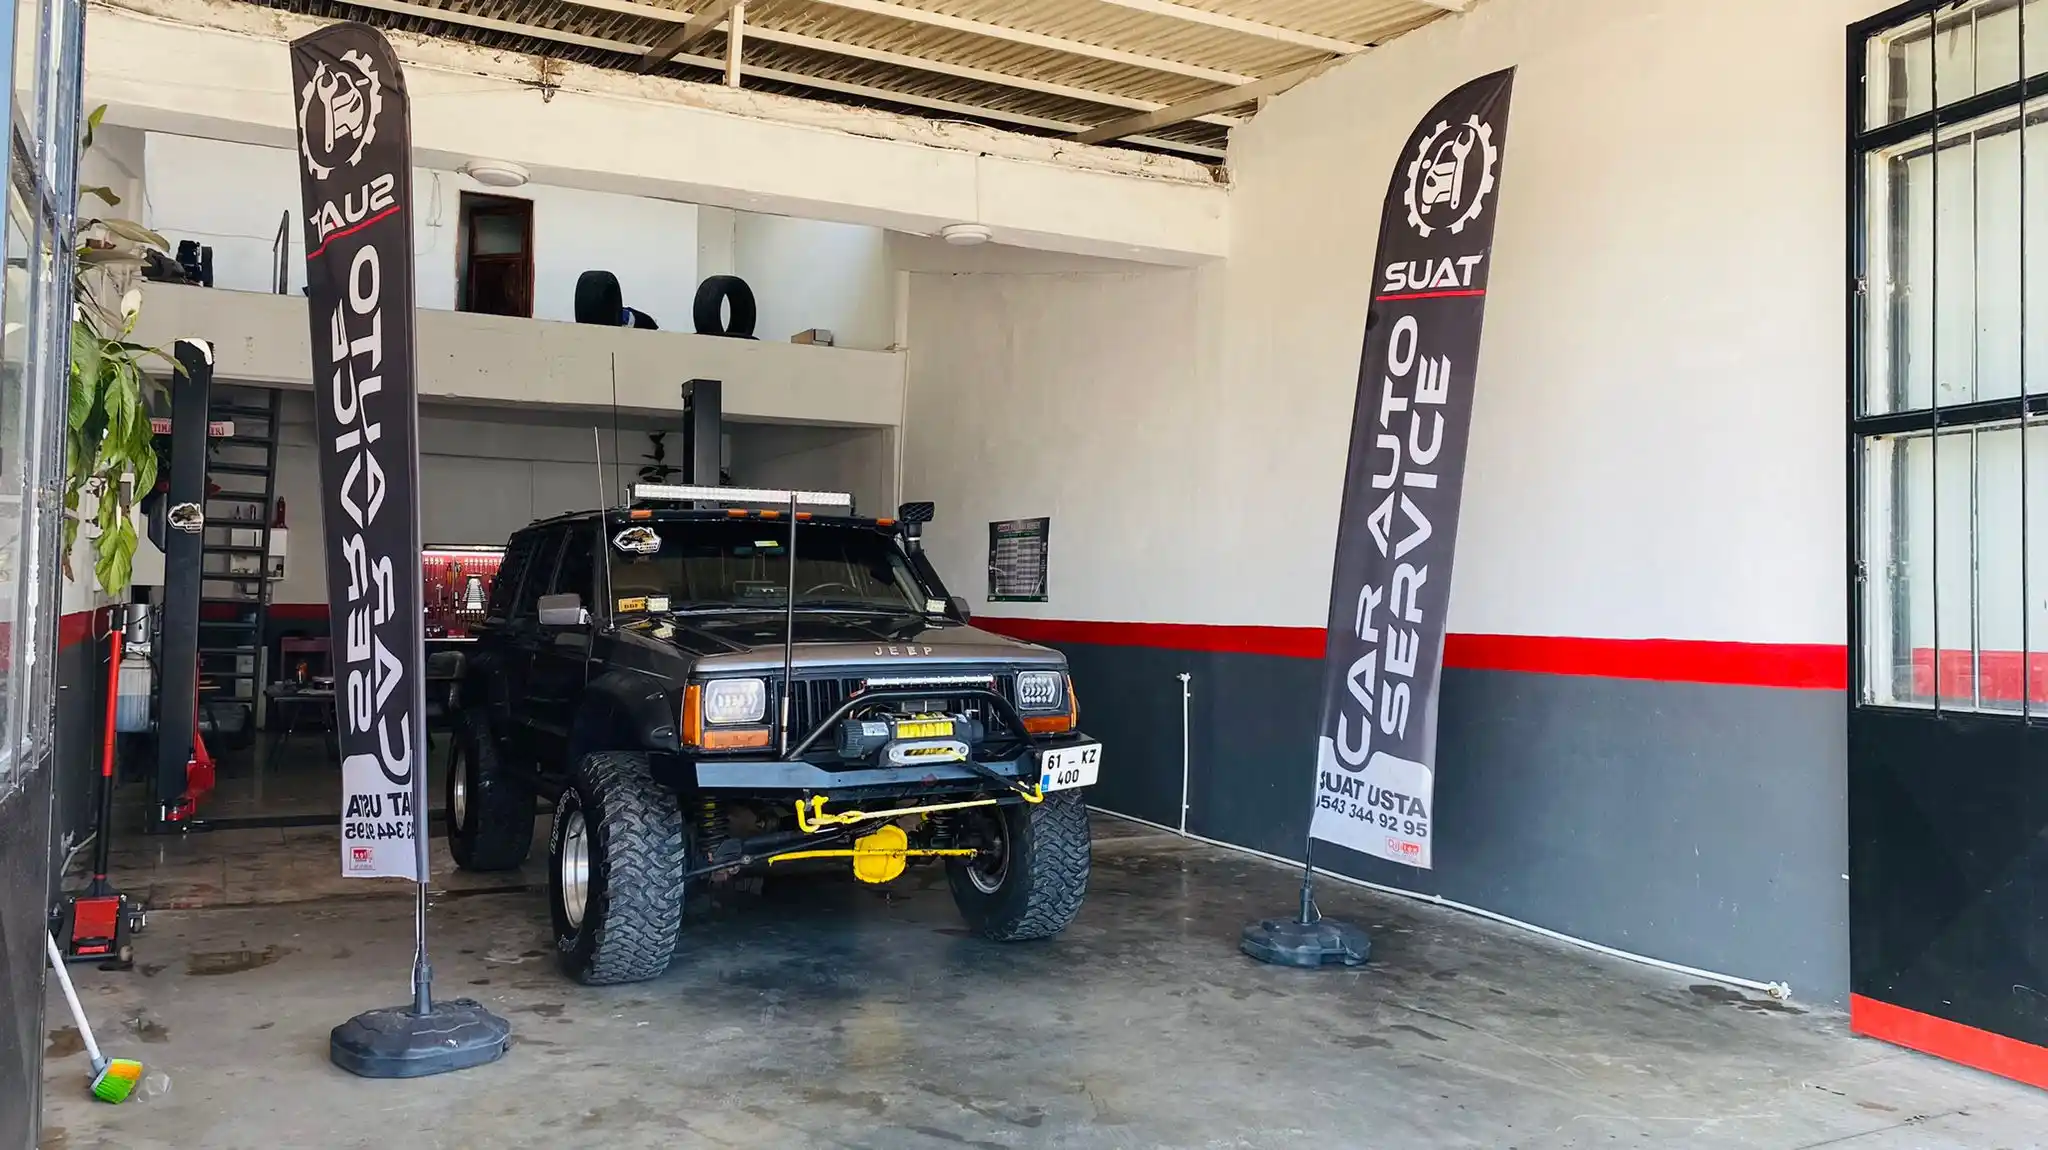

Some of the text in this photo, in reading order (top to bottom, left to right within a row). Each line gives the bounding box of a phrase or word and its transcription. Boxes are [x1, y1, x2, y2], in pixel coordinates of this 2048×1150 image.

[1383, 255, 1484, 291] SUAT
[1337, 315, 1418, 767] CAR AUTO
[1380, 354, 1452, 741] SERVICE
[874, 646, 933, 656] JEEP
[1047, 754, 1062, 770] 61
[1081, 749, 1097, 765] KZ
[1057, 769, 1080, 785] 400
[1367, 785, 1427, 819] USTA
[1348, 803, 1375, 824] 344
[1380, 813, 1398, 832] 92
[1404, 820, 1427, 837] 95
